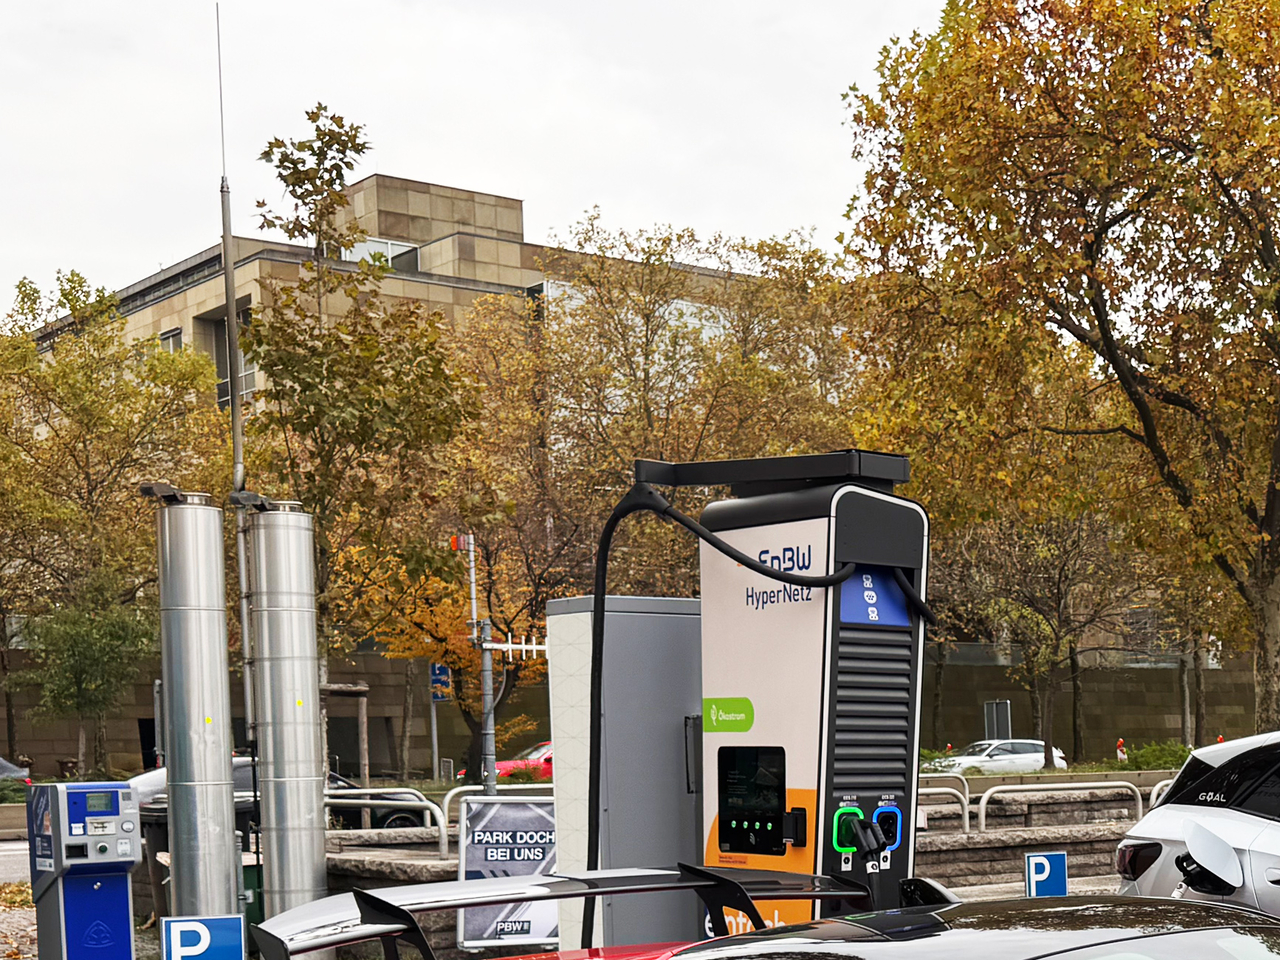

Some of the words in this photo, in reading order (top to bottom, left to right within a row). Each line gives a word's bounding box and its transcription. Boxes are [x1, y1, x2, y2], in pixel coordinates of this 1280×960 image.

[746, 584, 812, 610] HyperNetz
[474, 831, 513, 843] PARK
[516, 831, 555, 843] DOCH
[487, 849, 510, 860] BEI
[514, 848, 543, 860] UNS
[1029, 856, 1051, 897] P
